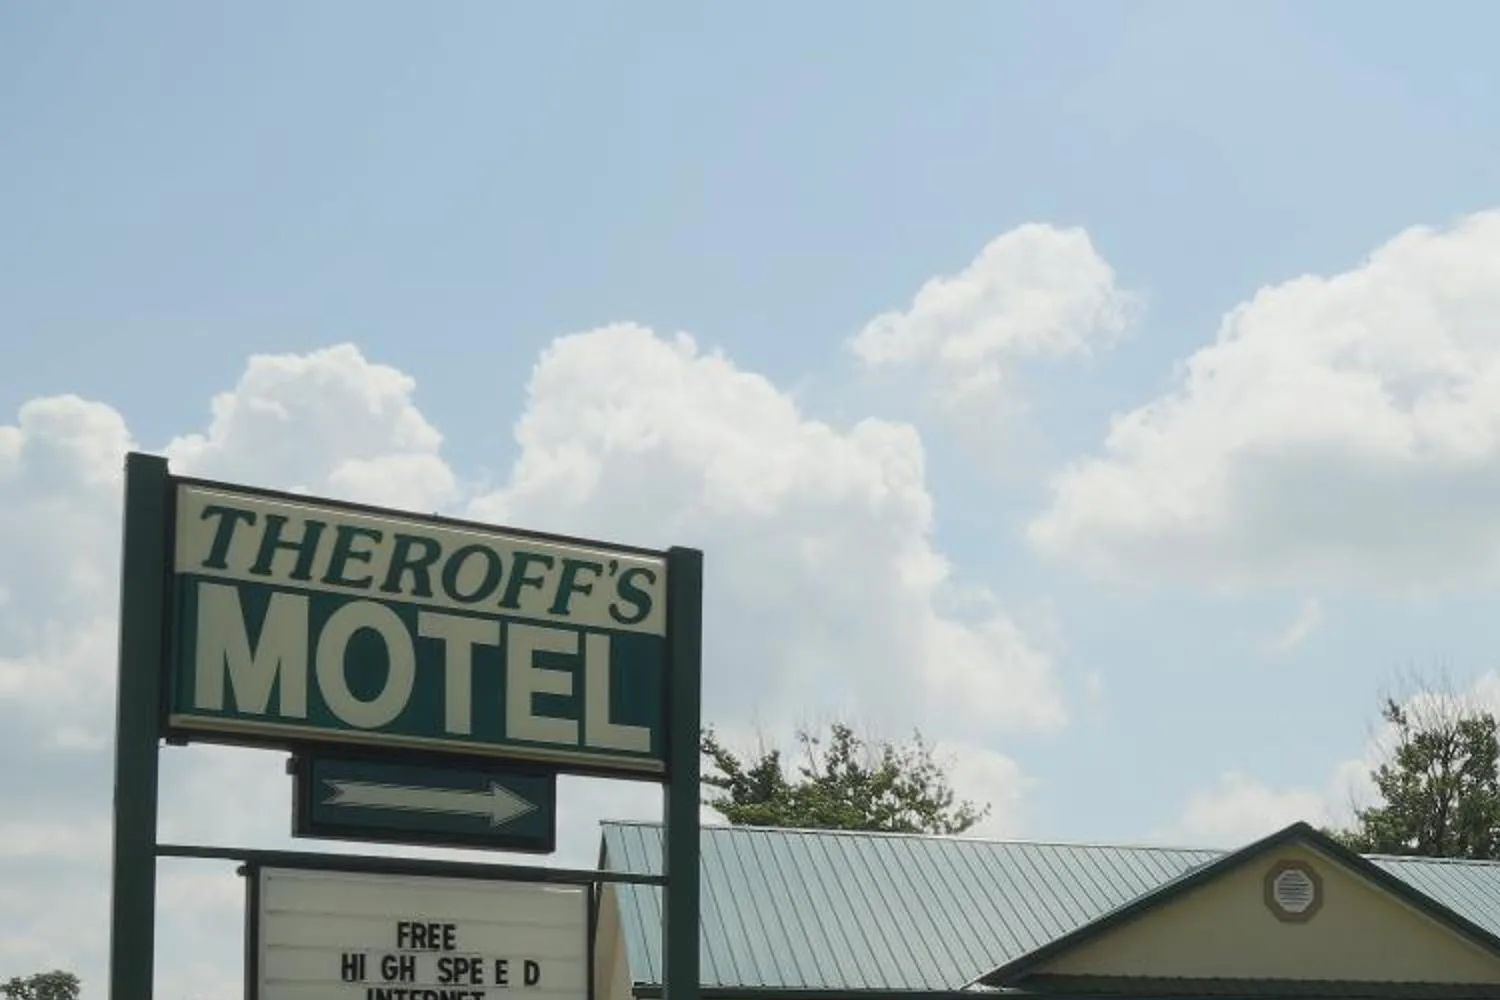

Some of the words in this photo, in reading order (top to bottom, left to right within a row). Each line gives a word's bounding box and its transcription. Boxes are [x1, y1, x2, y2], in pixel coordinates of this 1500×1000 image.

[201, 504, 657, 626] THEROFF'S
[194, 583, 652, 754] MOTEL
[341, 953, 416, 982] HIGH
[437, 957, 541, 987] SPEED
[397, 921, 456, 950] FREE
